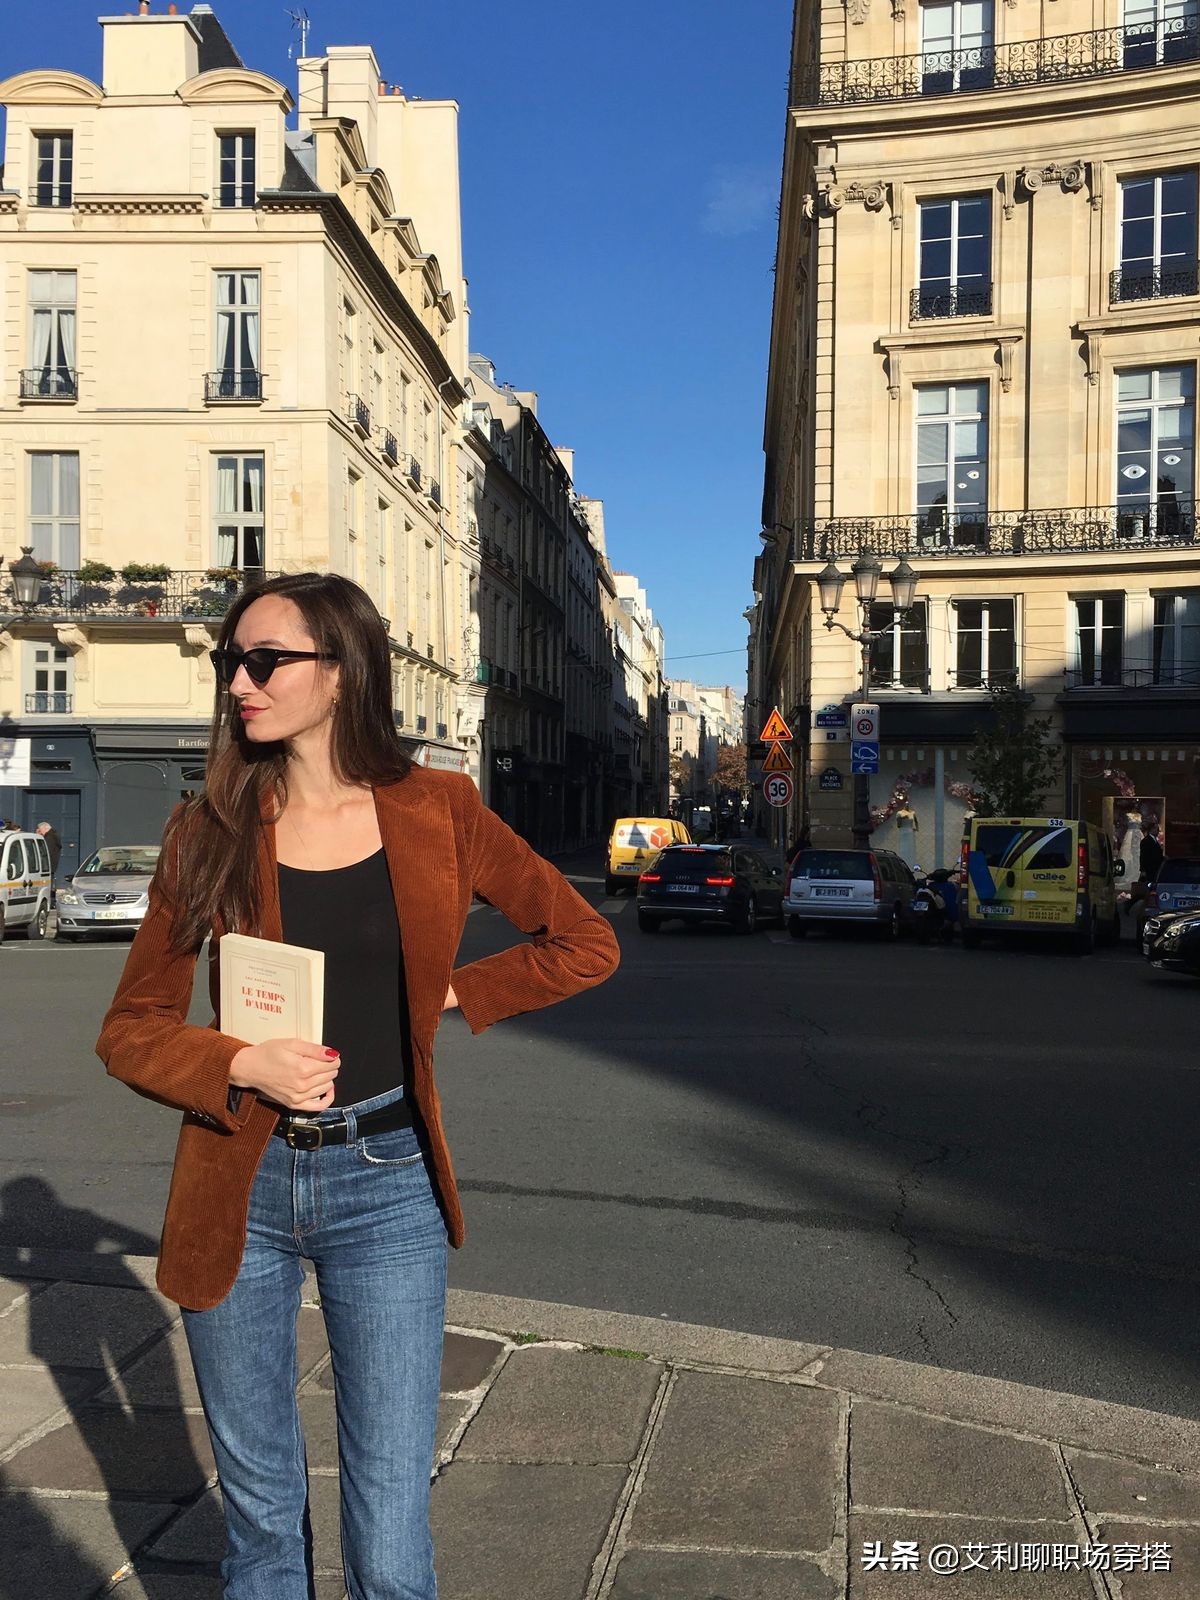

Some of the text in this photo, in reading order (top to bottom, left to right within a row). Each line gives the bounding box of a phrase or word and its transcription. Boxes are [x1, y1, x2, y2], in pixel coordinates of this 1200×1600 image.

[860, 723, 870, 731] 30
[178, 738, 210, 747] Hartfor
[242, 986, 286, 1003] LE TEMPS
[246, 998, 282, 1014] D'AIMER
